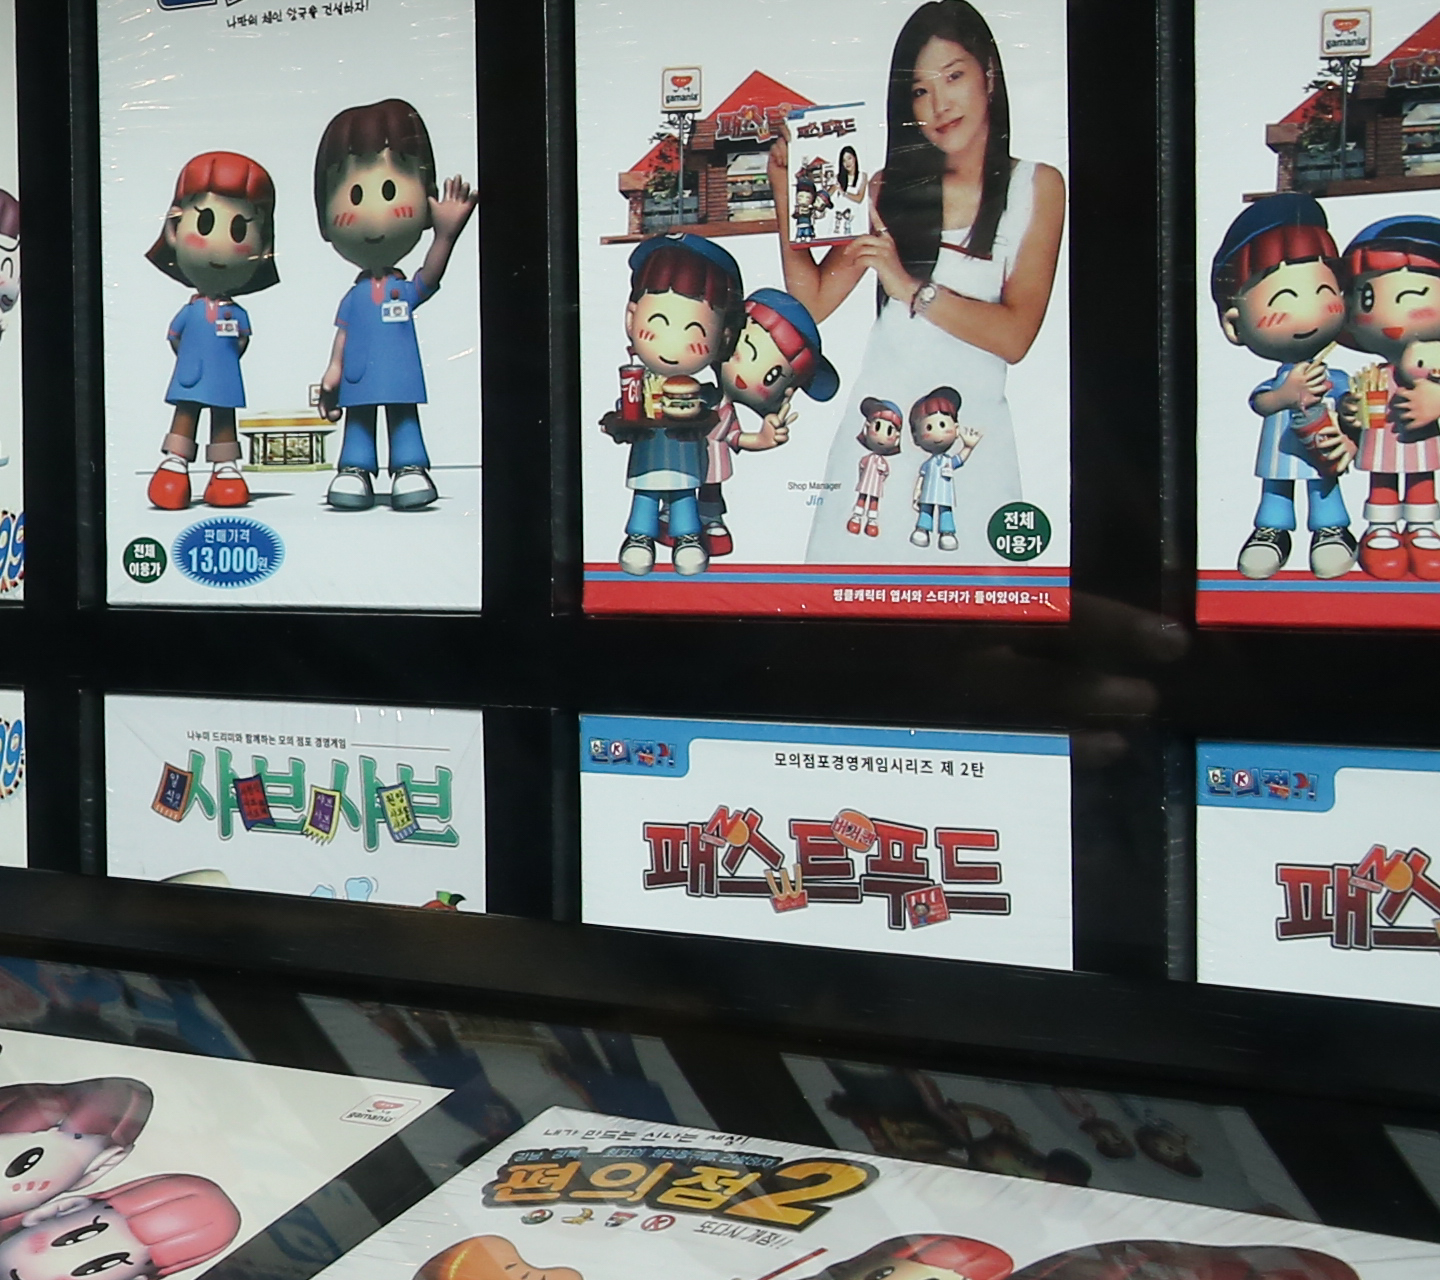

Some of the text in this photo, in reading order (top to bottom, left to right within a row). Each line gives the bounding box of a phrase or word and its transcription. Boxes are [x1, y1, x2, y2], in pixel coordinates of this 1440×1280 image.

[1326, 37, 1367, 50] gamania
[665, 92, 699, 104] gamania
[787, 481, 842, 491] Shop Manager
[806, 495, 824, 506] Jin
[1003, 511, 1035, 531] 전체
[204, 528, 251, 543] 판매가격
[133, 543, 156, 558] 전체
[996, 535, 1043, 554] 이용가
[188, 546, 268, 575] 13,000원
[129, 562, 162, 577] 이용가
[833, 588, 886, 602] 핑클캐릭터
[890, 589, 922, 603] 엽서와
[926, 590, 970, 604] 스티커가
[186, 730, 347, 750] 나누미 드리미와 함께하는 모의 점포 경영게임
[774, 752, 984, 779] 모의점포경영게임시리즈 제 2탄
[642, 805, 1011, 930] 패스트푸드
[543, 1128, 579, 1137] 내가
[581, 1129, 637, 1141] 만드는
[641, 1131, 698, 1143] 신나는
[482, 1156, 881, 1233] 편의점2
[693, 1221, 741, 1240] 또다시
